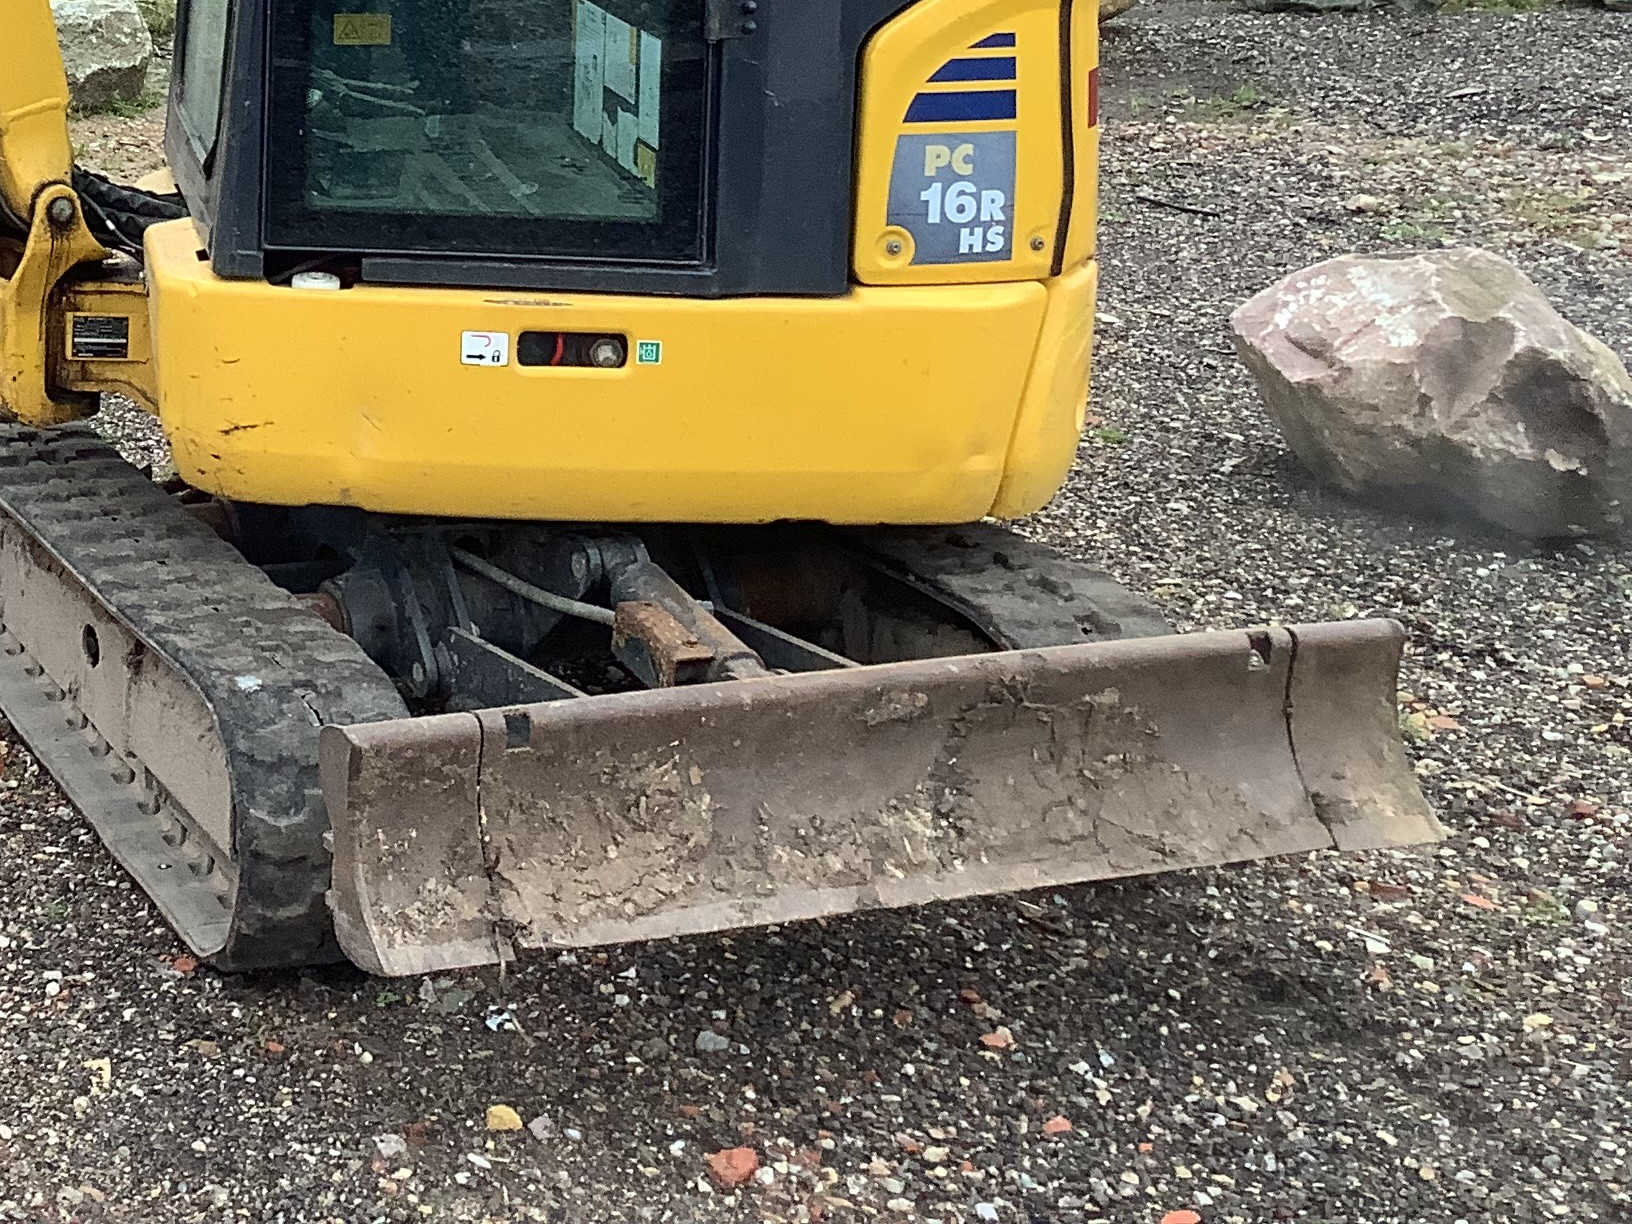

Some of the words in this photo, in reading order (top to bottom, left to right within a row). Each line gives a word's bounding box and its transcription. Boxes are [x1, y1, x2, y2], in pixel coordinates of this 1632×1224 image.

[924, 143, 974, 176] PC
[920, 182, 1006, 224] 16R
[959, 226, 1005, 254] HS
